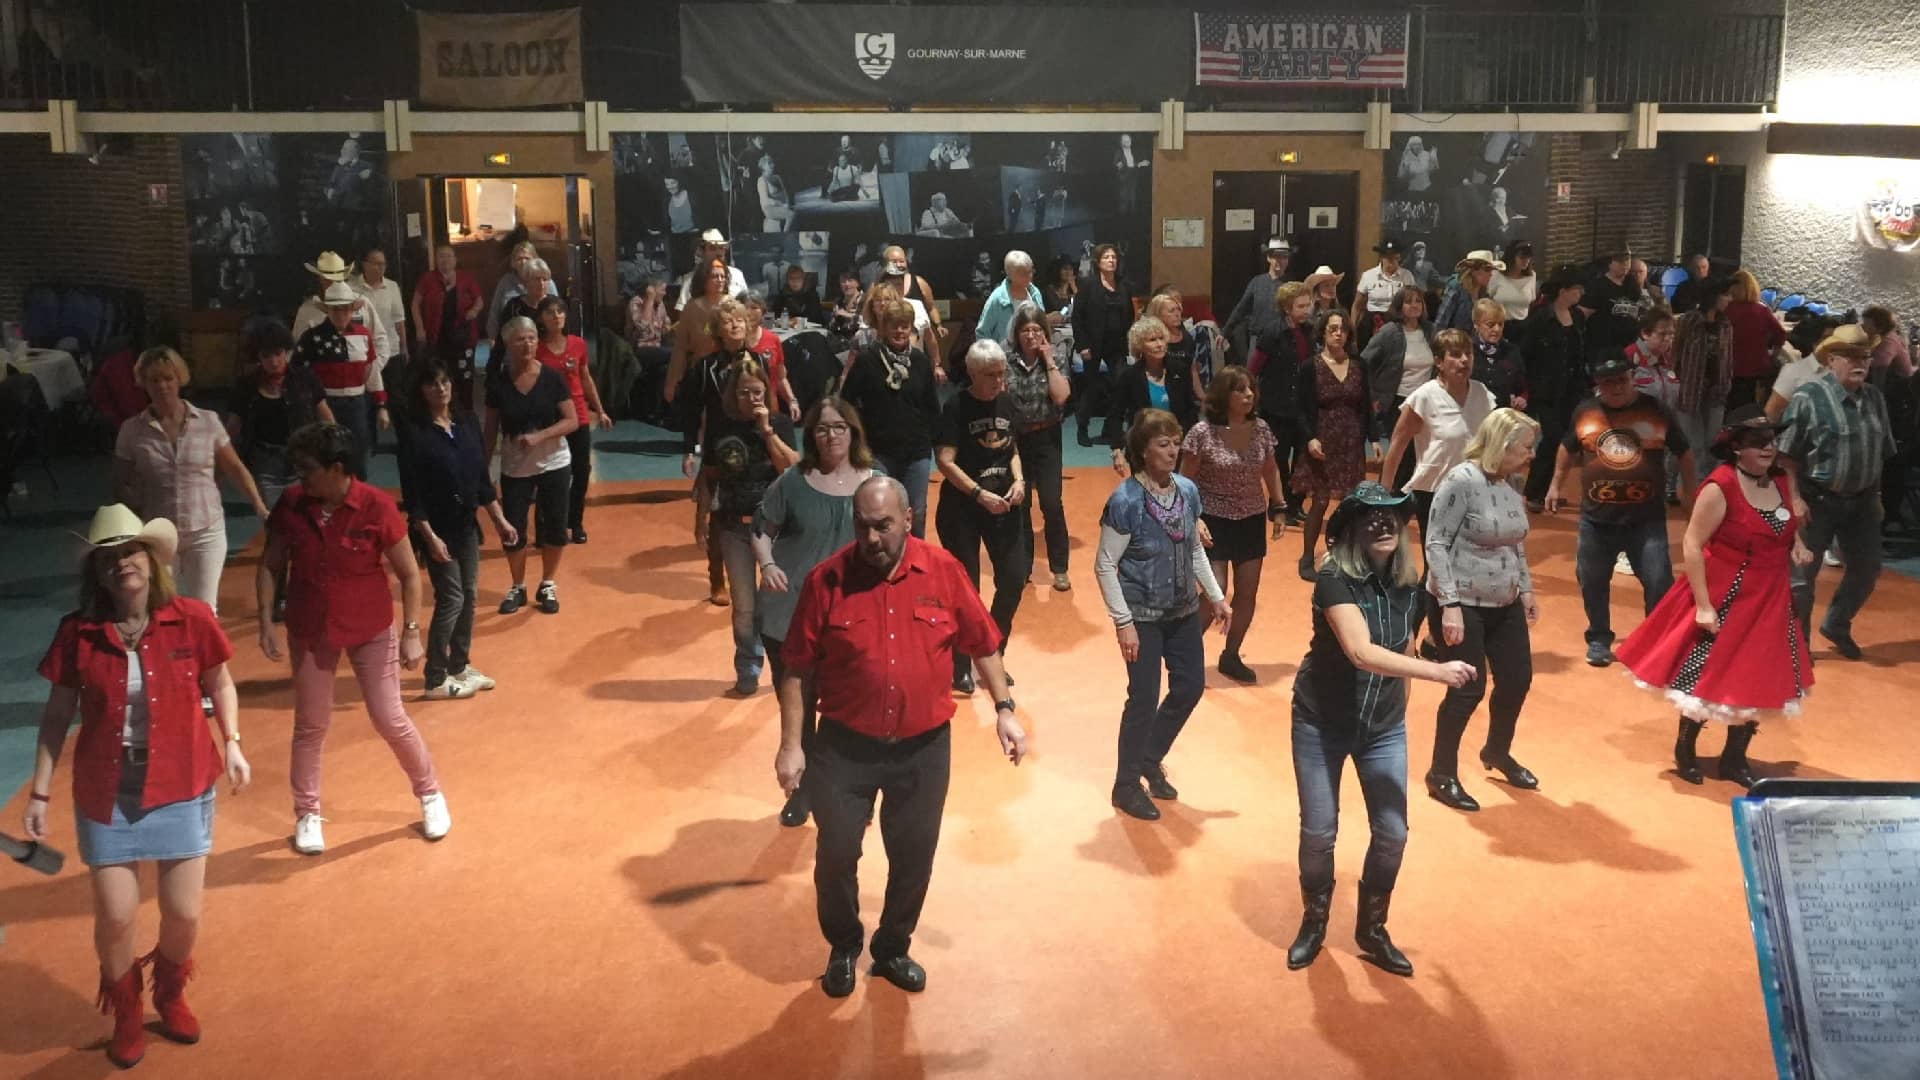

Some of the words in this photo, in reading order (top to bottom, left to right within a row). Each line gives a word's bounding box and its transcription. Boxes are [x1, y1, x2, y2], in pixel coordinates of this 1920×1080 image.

[863, 33, 888, 58] G
[1223, 23, 1383, 53] AMERICAN
[436, 38, 569, 78] SALOON
[906, 49, 1027, 60] GOURNAY-SUR-MARNE
[1238, 47, 1371, 81] PARTY
